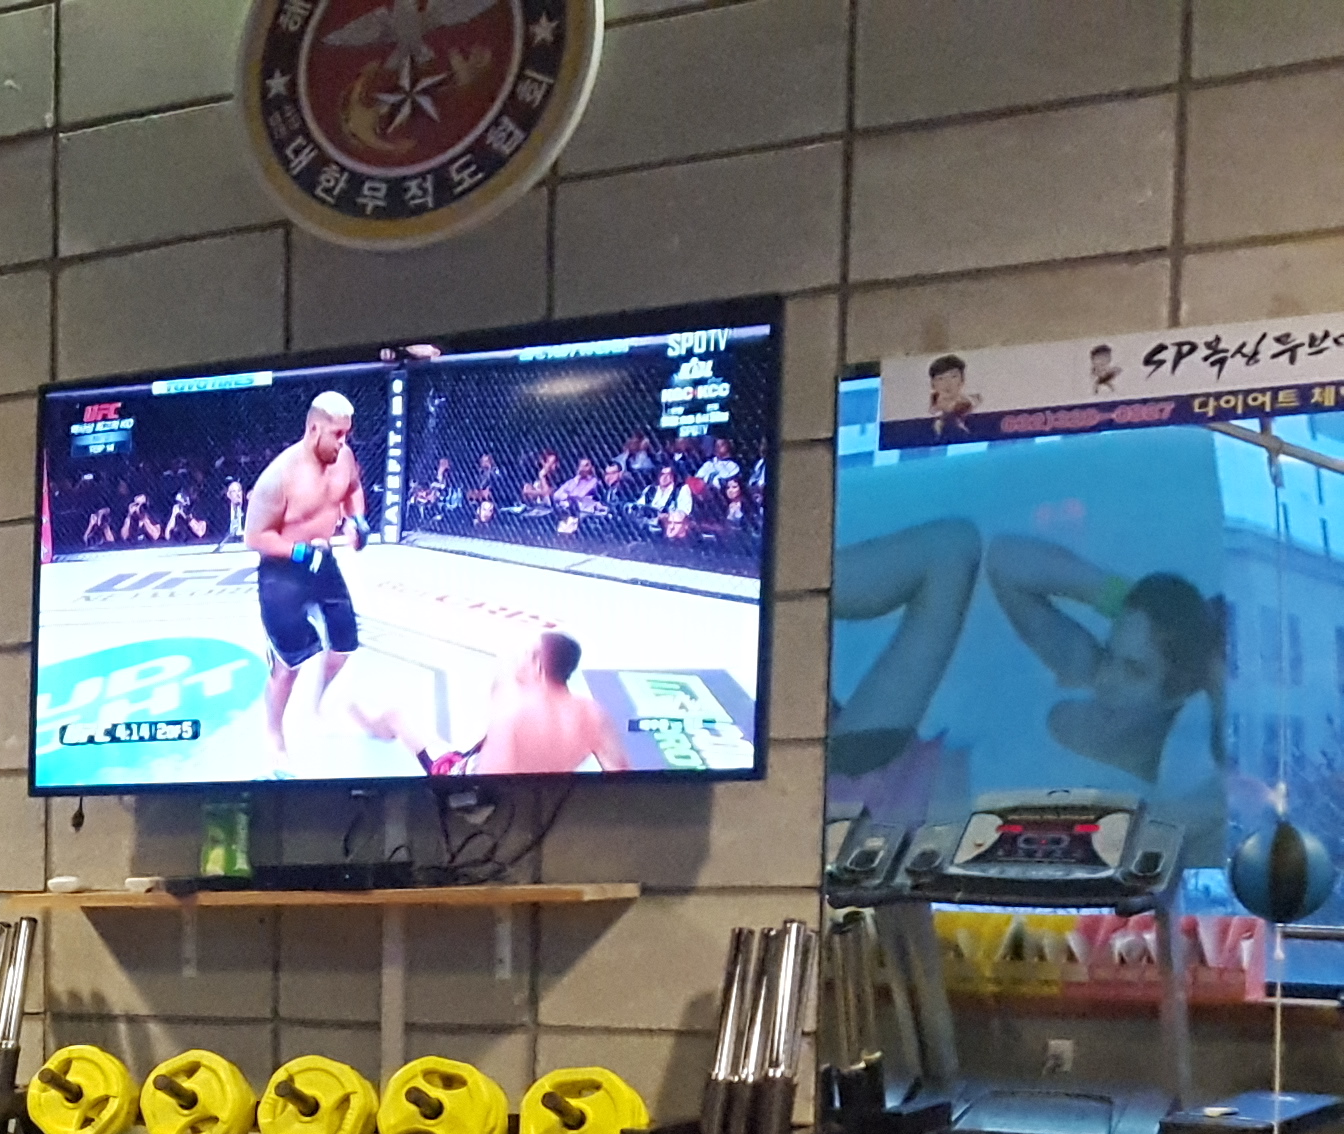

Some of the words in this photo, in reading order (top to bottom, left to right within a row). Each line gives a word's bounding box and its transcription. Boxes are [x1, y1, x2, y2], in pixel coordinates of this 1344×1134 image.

[666, 328, 730, 356] SPOTV
[82, 402, 123, 422] UFC
[1193, 390, 1300, 417] 다이어트
[1310, 386, 1344, 406] 체
